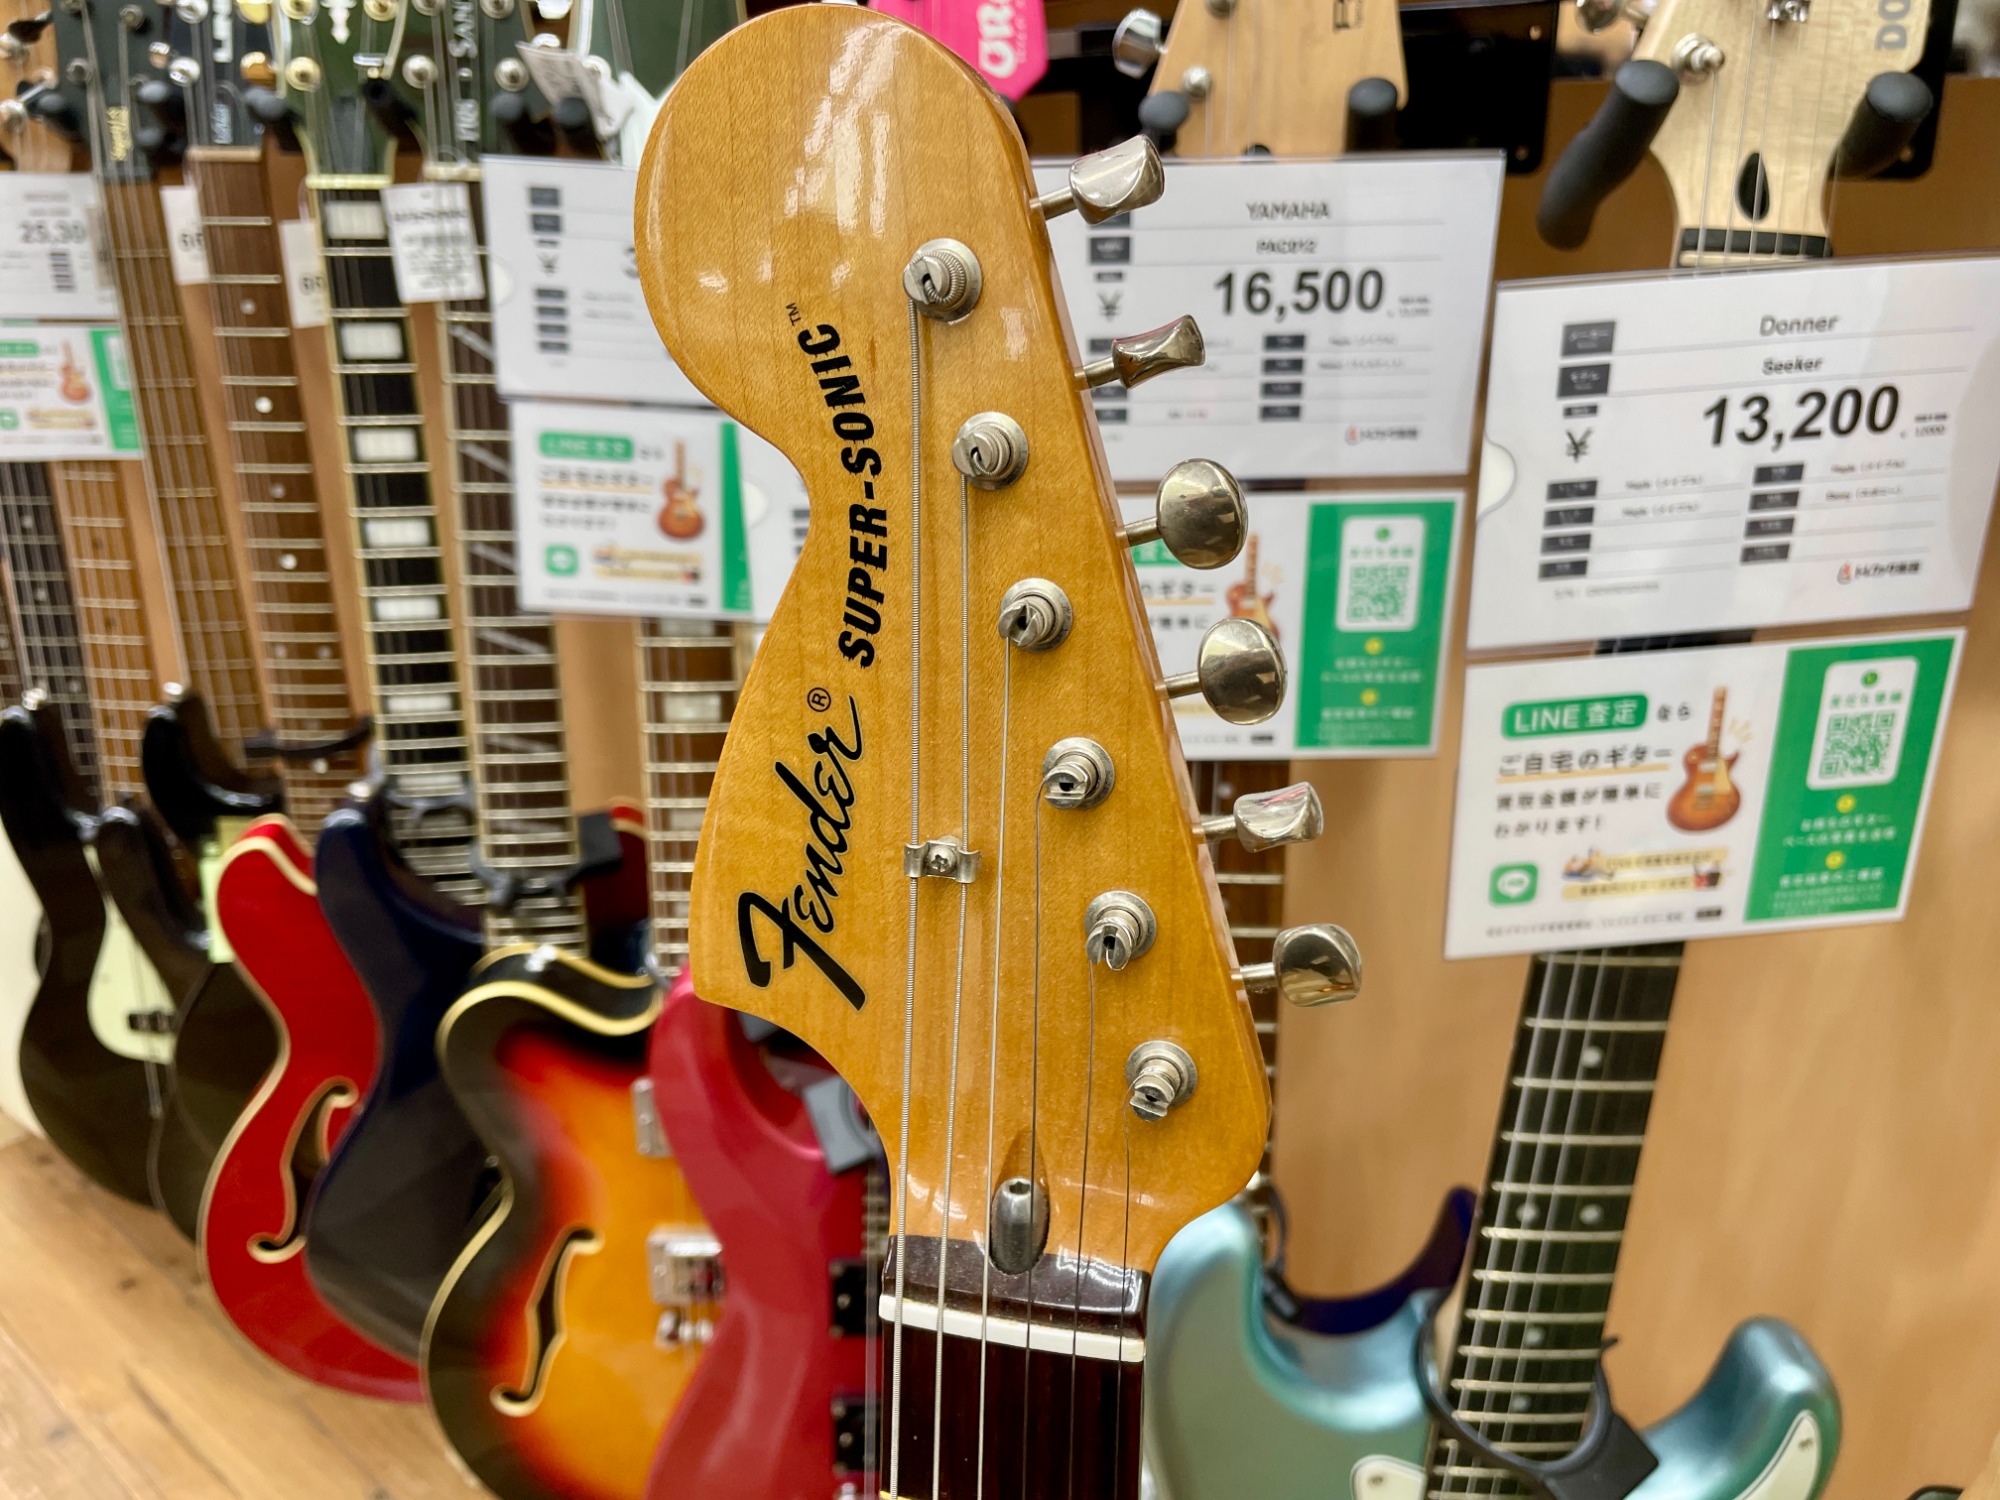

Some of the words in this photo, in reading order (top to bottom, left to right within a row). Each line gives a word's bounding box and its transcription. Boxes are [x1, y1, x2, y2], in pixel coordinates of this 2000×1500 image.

[976, 0, 1016, 78] OR
[1246, 202, 1331, 220] YAMAHA
[1098, 290, 1122, 321] ¥
[1214, 268, 1385, 322] 16,500
[1760, 314, 1839, 336] Donner
[1762, 355, 1823, 375] Seeker
[1565, 426, 1593, 462] ¥
[1703, 383, 1900, 452] 13,200
[797, 323, 888, 669] SUPER-SONIC
[1513, 704, 1580, 733] LINE
[1499, 744, 1672, 777] ご自宅のギター
[738, 695, 866, 1011] Fender
